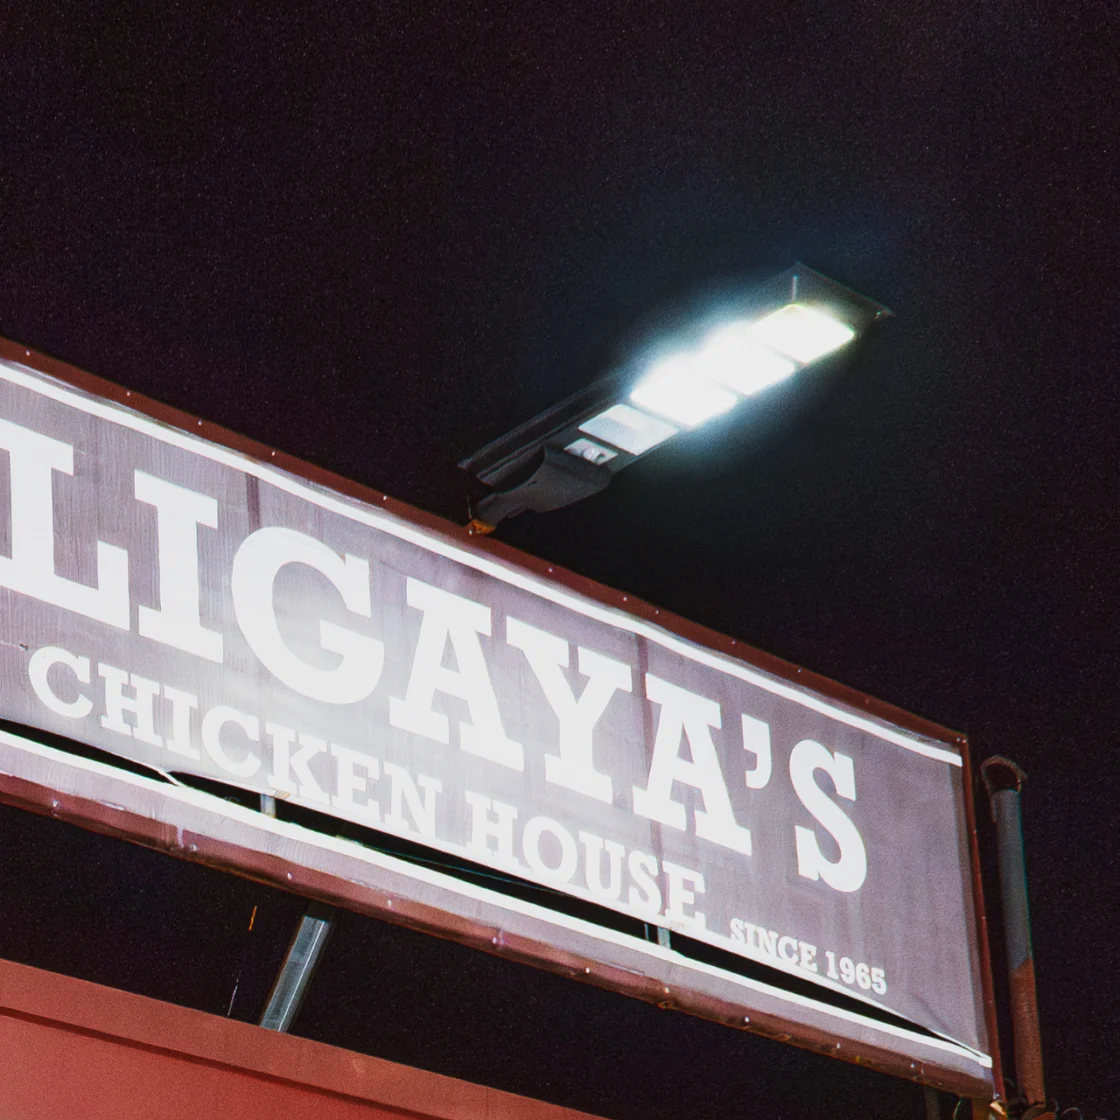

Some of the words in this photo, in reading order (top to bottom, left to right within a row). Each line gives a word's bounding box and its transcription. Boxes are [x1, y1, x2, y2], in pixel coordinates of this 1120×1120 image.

[28, 646, 443, 838] CHICKEN
[465, 791, 707, 932] HOUSE
[729, 917, 818, 973] SINCE
[825, 950, 888, 996] 1965
